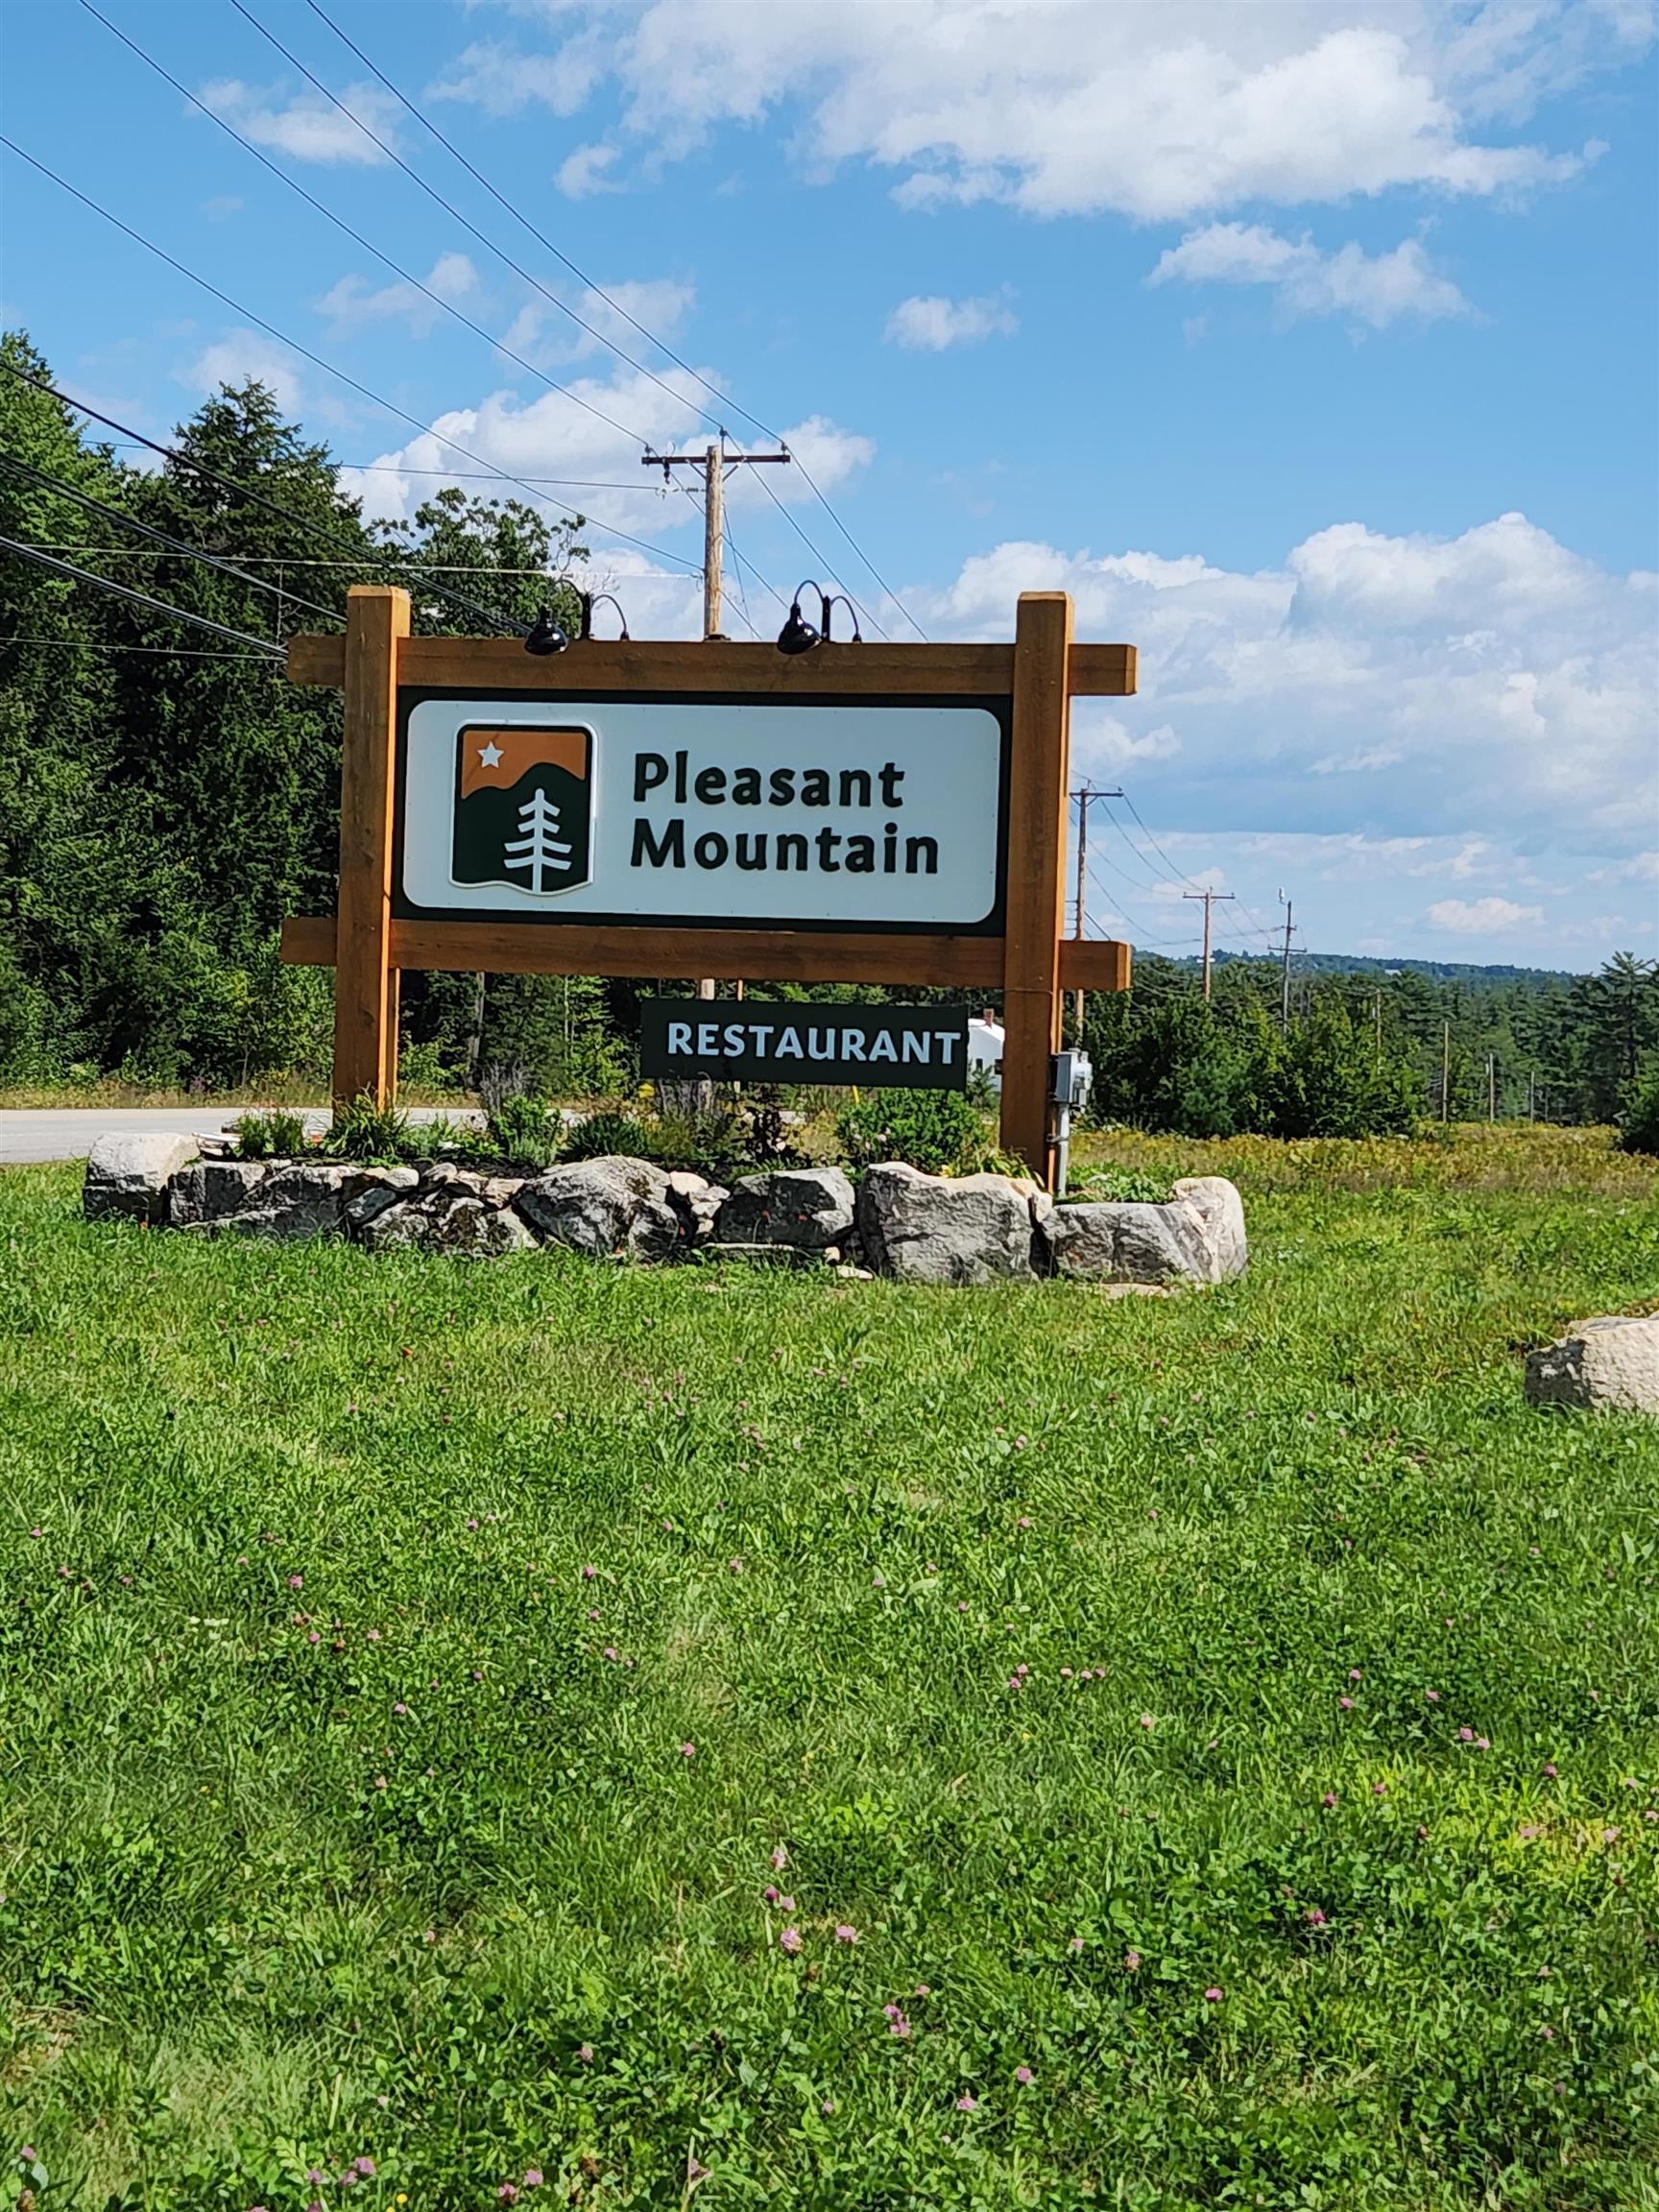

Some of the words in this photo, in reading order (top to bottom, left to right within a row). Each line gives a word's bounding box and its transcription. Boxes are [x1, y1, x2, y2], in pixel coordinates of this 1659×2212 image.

[633, 749, 906, 808] Pleasant
[630, 817, 939, 875] Mountain
[667, 1022, 962, 1065] RESTAURANT
